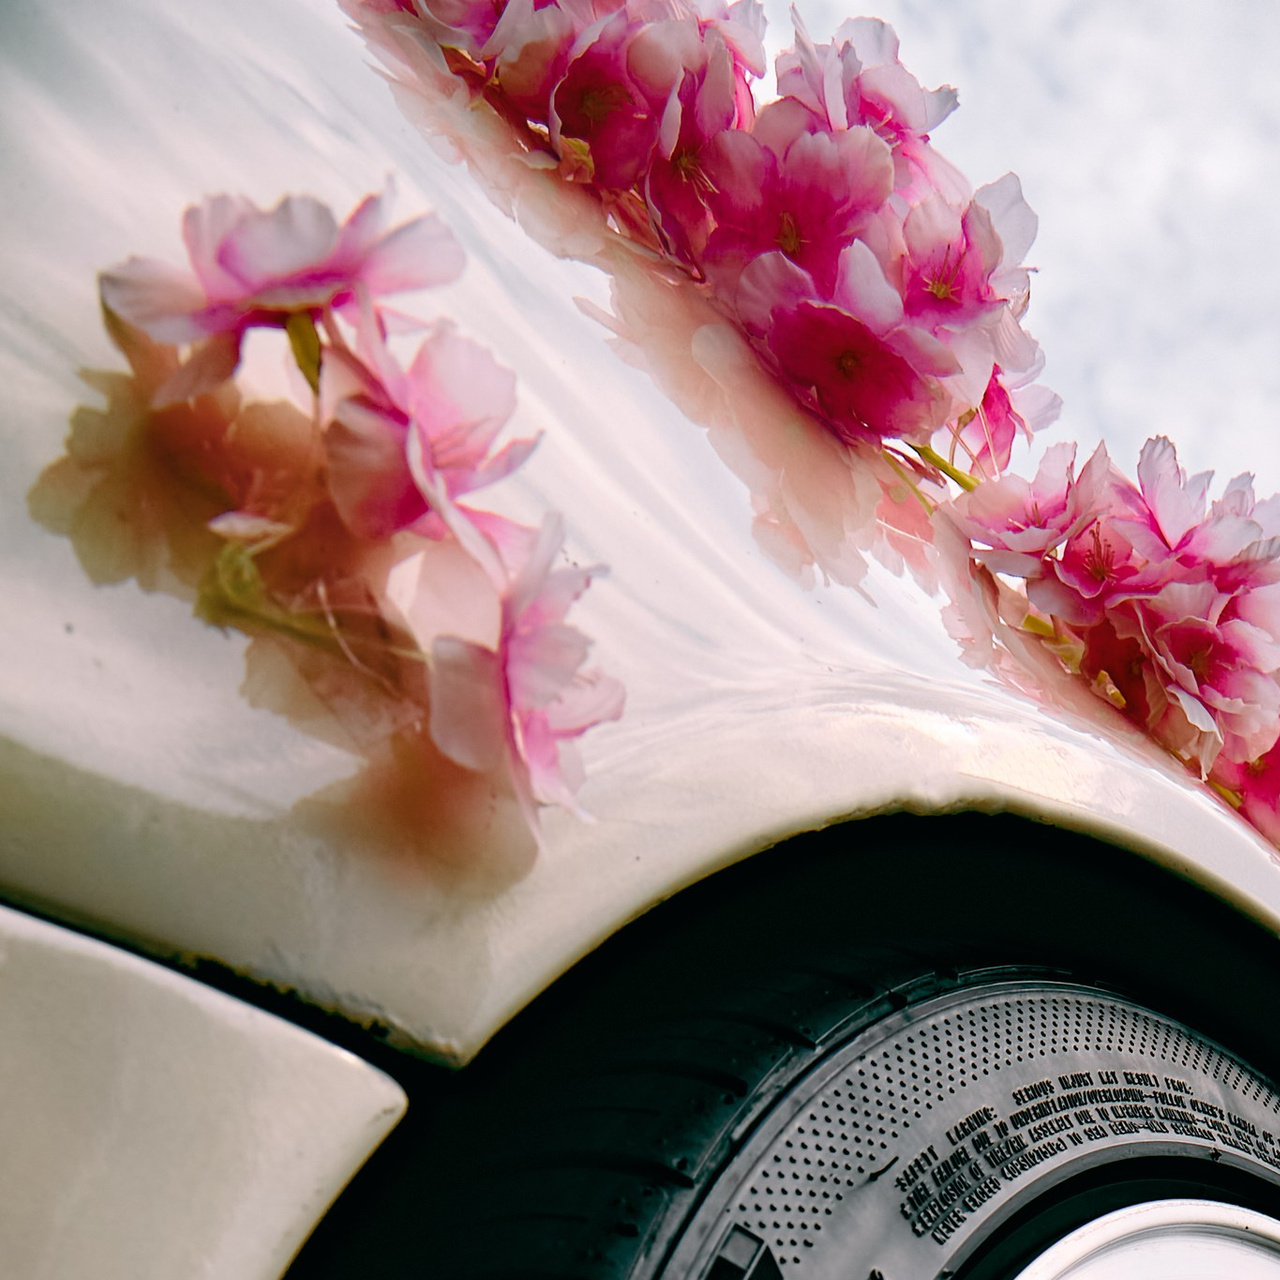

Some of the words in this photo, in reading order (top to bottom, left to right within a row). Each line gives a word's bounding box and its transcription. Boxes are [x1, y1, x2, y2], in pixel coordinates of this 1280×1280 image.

[918, 1171, 972, 1229] EXPLOSION
[931, 1208, 967, 1245] NEVER
[962, 1175, 1002, 1213] EXCEED
